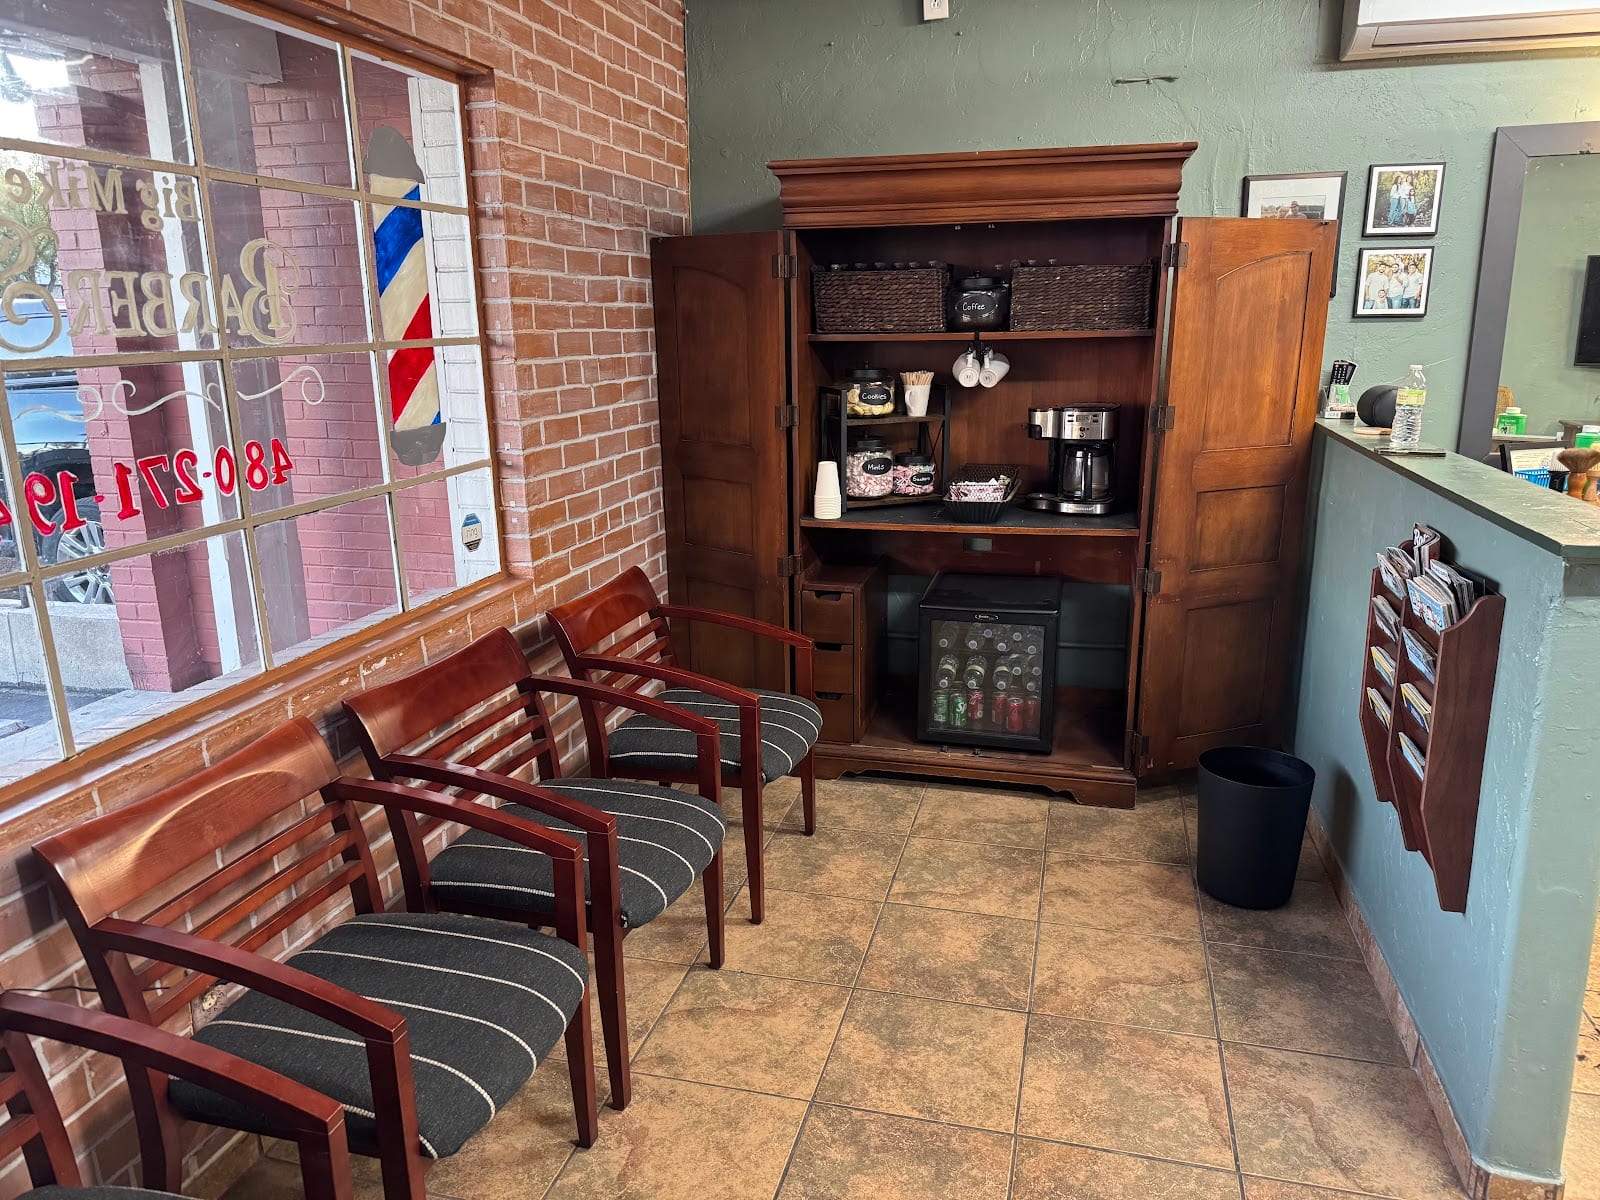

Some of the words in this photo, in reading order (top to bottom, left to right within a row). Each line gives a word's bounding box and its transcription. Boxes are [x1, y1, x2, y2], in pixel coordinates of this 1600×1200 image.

[962, 301, 986, 311] Coffee
[861, 392, 887, 400] Cookies
[867, 463, 885, 471] Mints
